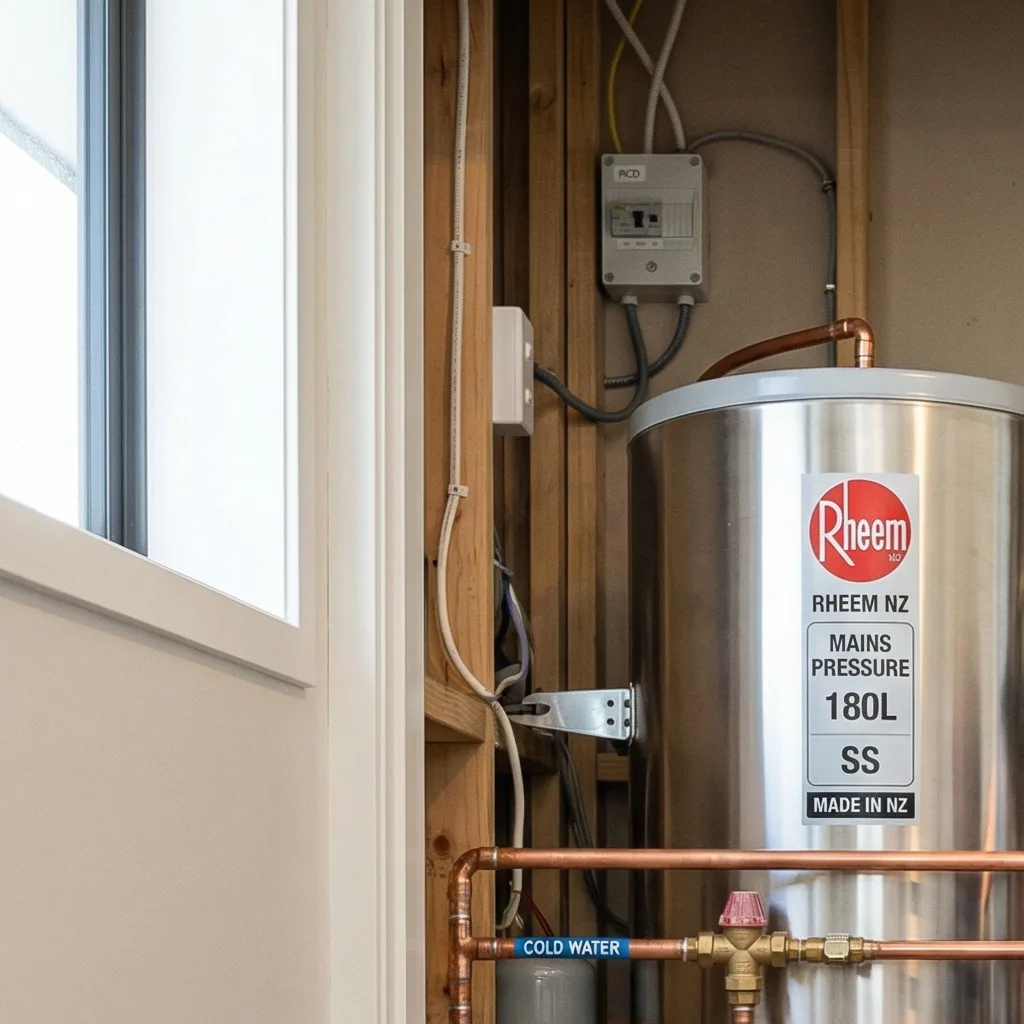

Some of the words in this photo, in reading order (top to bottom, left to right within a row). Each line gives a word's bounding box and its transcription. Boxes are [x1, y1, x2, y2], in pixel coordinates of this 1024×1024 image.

[619, 169, 640, 179] RCD
[819, 481, 907, 567] Rheem
[812, 594, 878, 613] RHEEM
[885, 595, 909, 613] NZ
[829, 634, 892, 652] MAINS
[812, 658, 910, 677] PRESSURE
[825, 691, 897, 721] 180L
[840, 745, 880, 775] SS
[813, 796, 860, 813] MADE
[865, 796, 882, 813] IN
[887, 796, 908, 813] NZ
[523, 939, 563, 956] COLD
[568, 940, 620, 956] WATER
